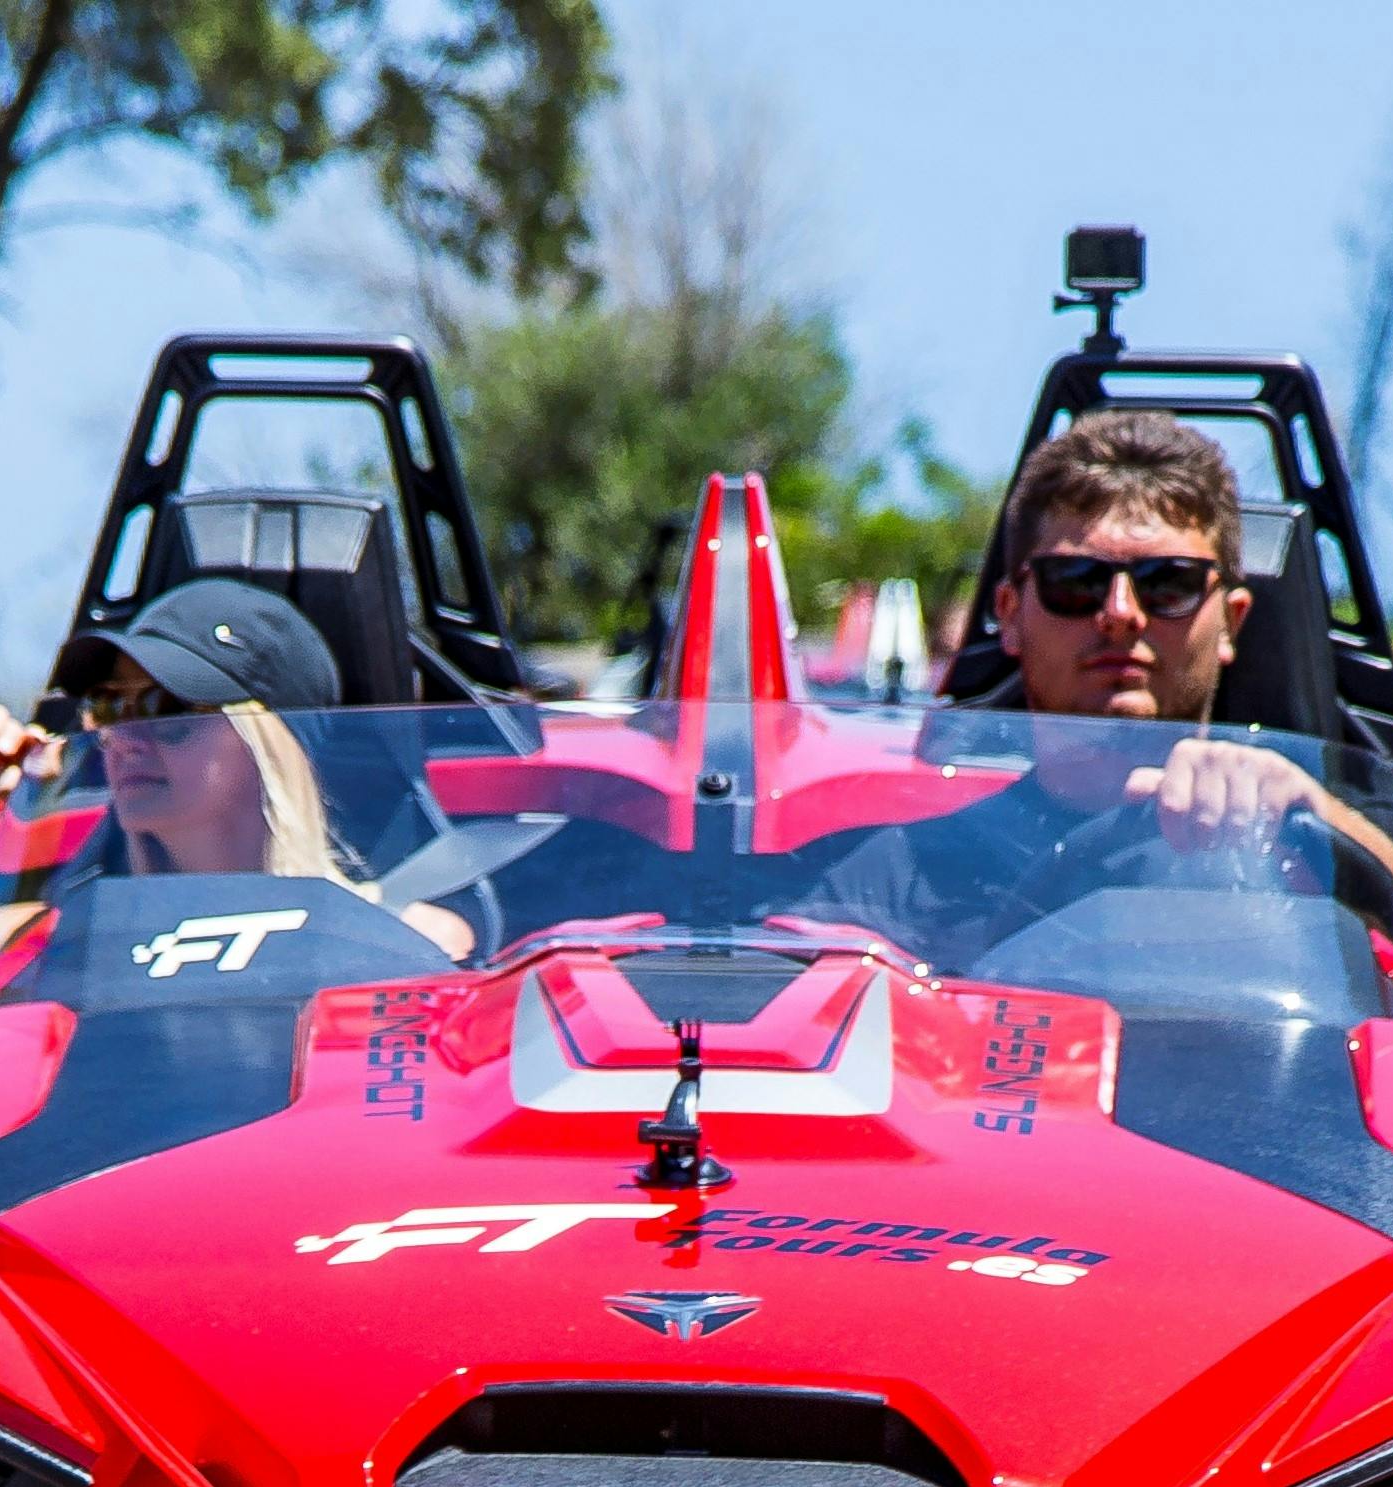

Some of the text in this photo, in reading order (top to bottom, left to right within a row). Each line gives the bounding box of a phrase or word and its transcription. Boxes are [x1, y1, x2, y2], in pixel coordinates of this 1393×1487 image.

[131, 908, 309, 978] FT
[975, 999, 1051, 1134] SLINGSHOT
[295, 1203, 679, 1264] FT
[661, 1229, 1090, 1286] Tours .es
[685, 1208, 1111, 1266] Formula
